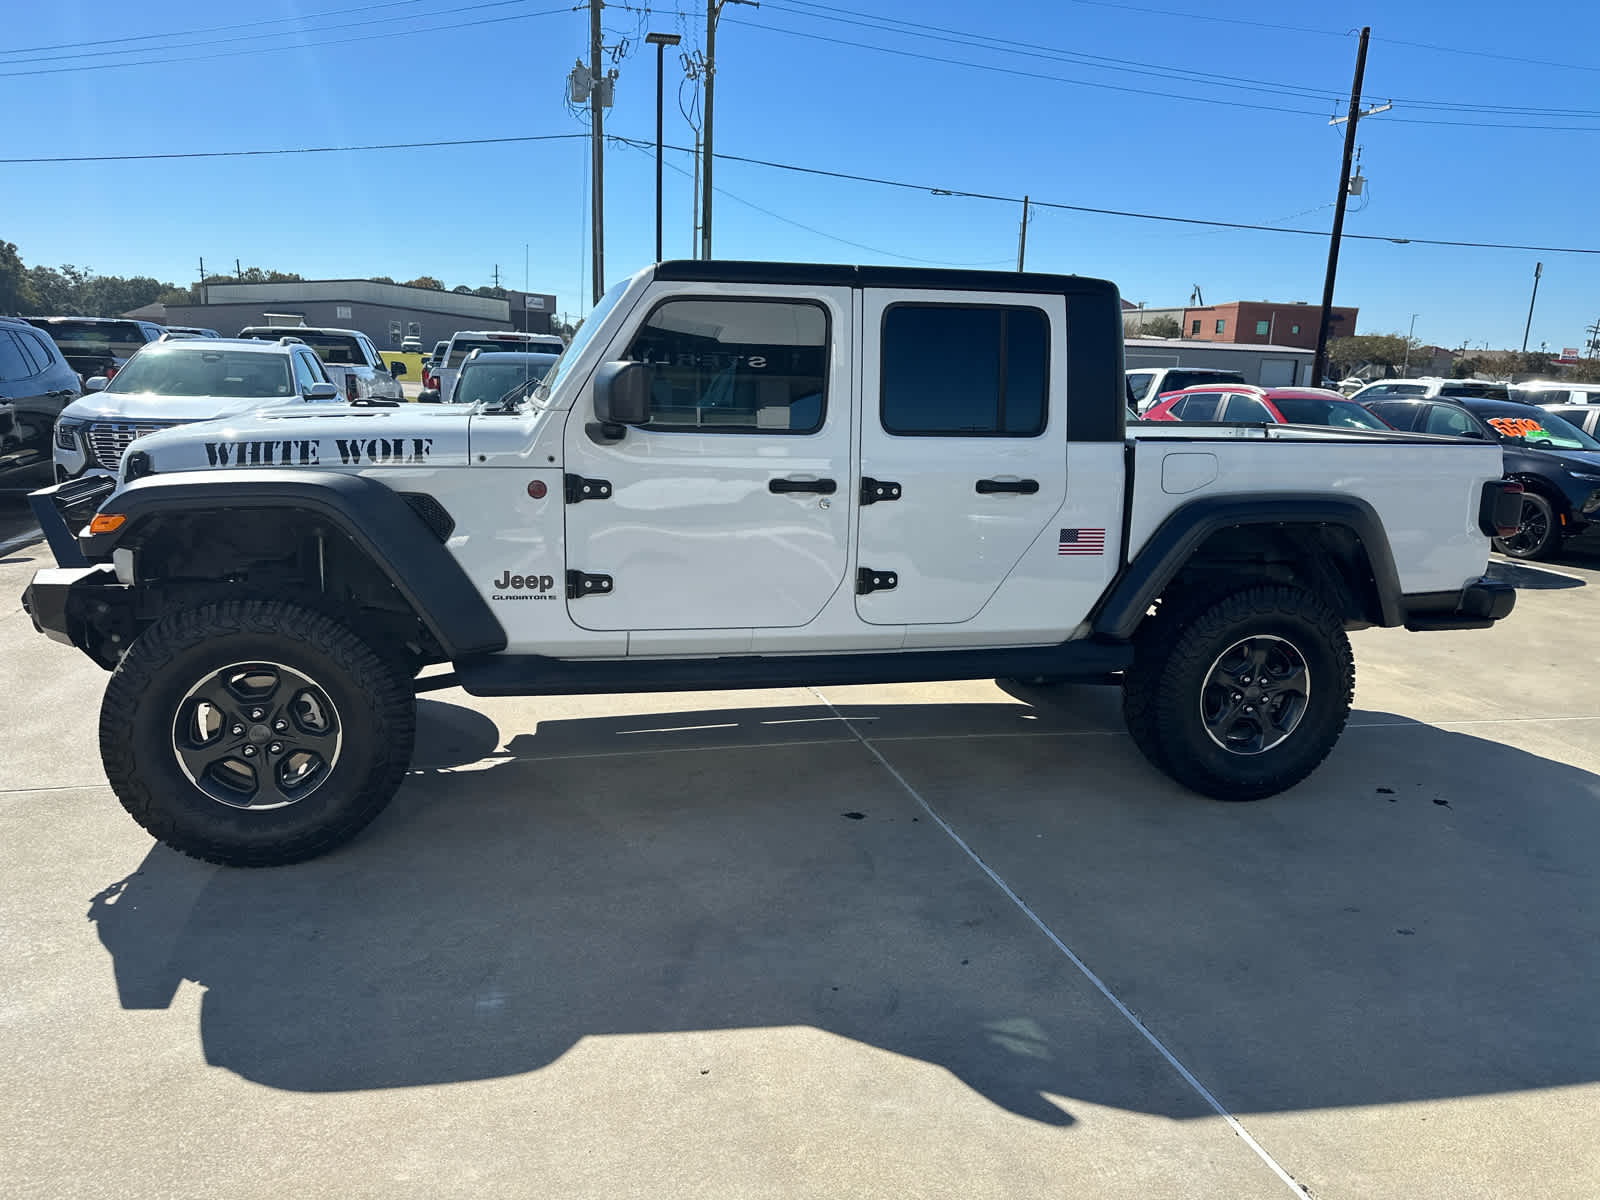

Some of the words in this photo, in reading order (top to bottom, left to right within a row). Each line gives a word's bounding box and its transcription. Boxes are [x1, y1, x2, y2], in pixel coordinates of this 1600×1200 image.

[204, 440, 320, 467] WHITE
[335, 438, 433, 465] WOLF
[494, 570, 554, 593] Jeep
